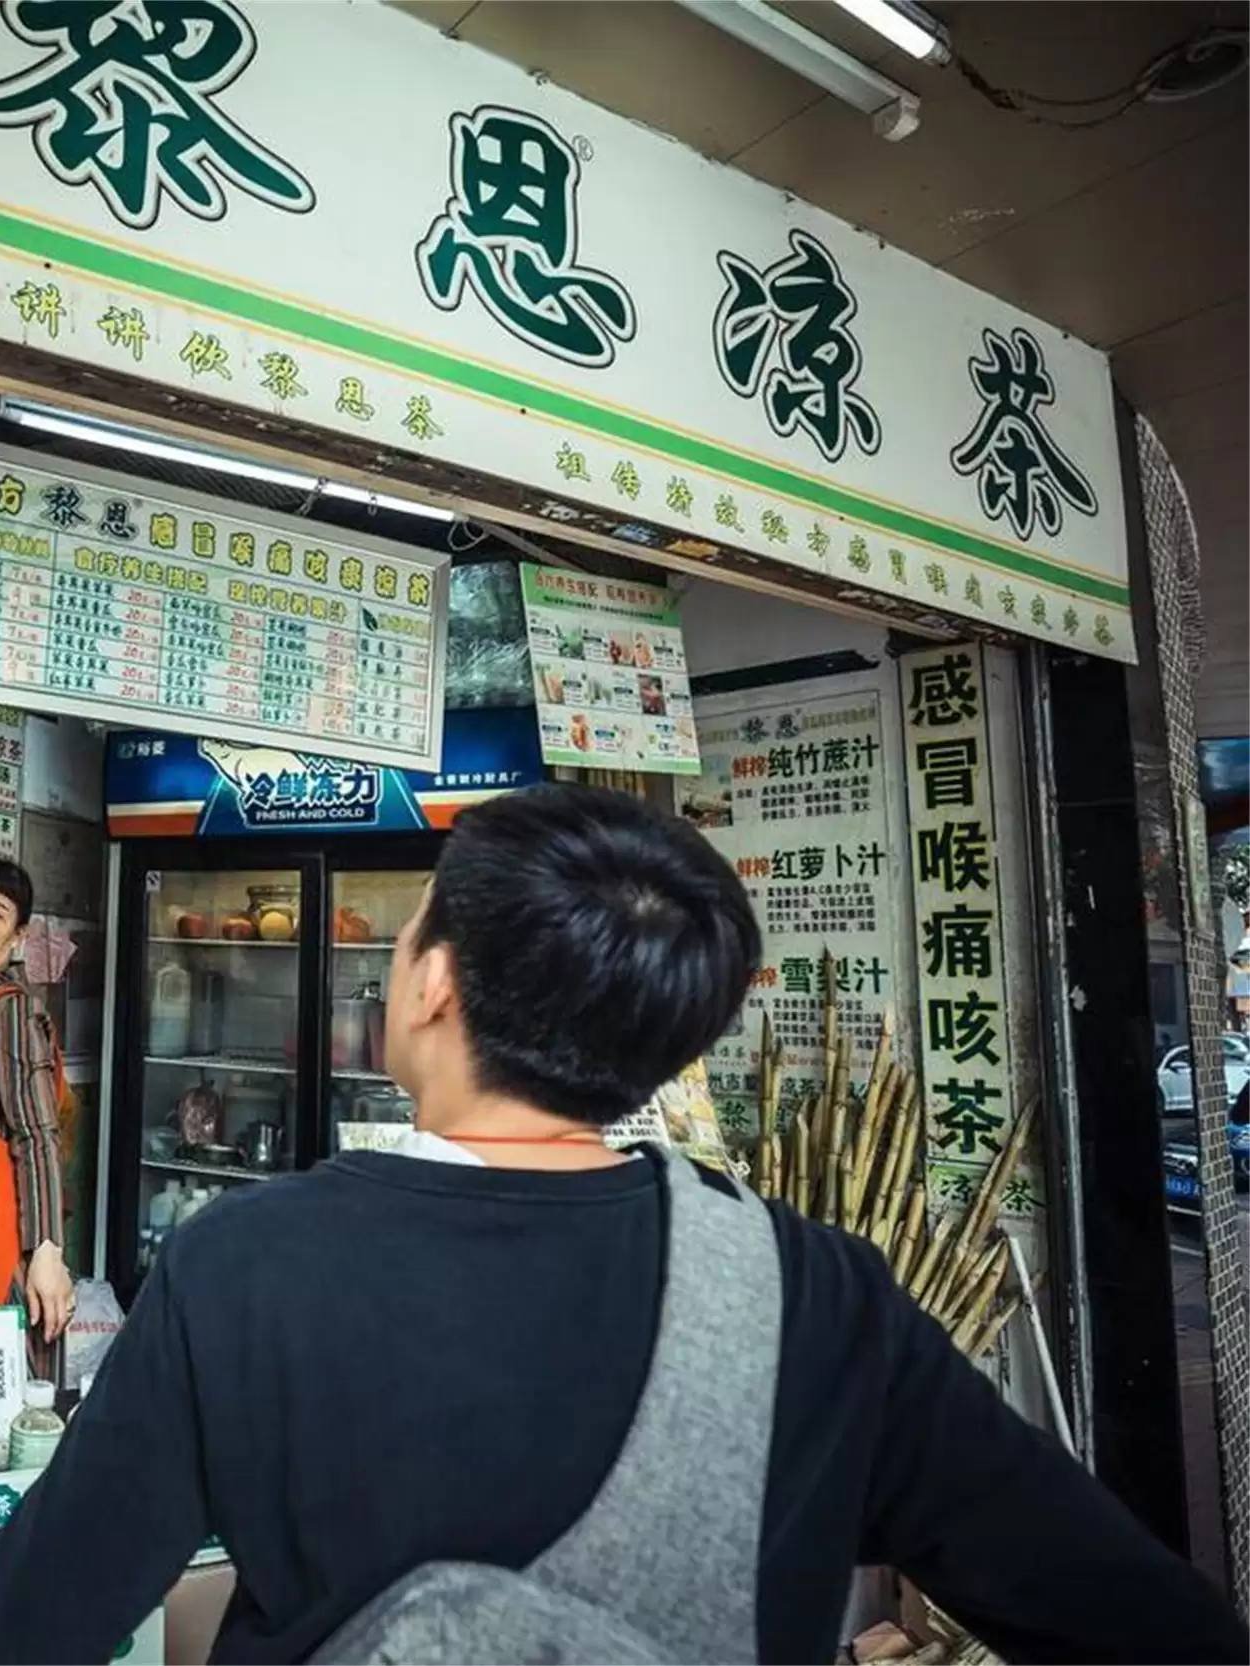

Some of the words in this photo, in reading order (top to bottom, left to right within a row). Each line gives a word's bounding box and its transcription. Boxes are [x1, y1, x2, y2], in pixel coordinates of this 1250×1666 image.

[242, 763, 380, 808] 冷鲜冻力
[256, 809, 297, 820] FRESH
[298, 808, 327, 819] AND
[329, 807, 365, 818] COLD
[910, 653, 1007, 1155] 感冒喉痛咳茶
